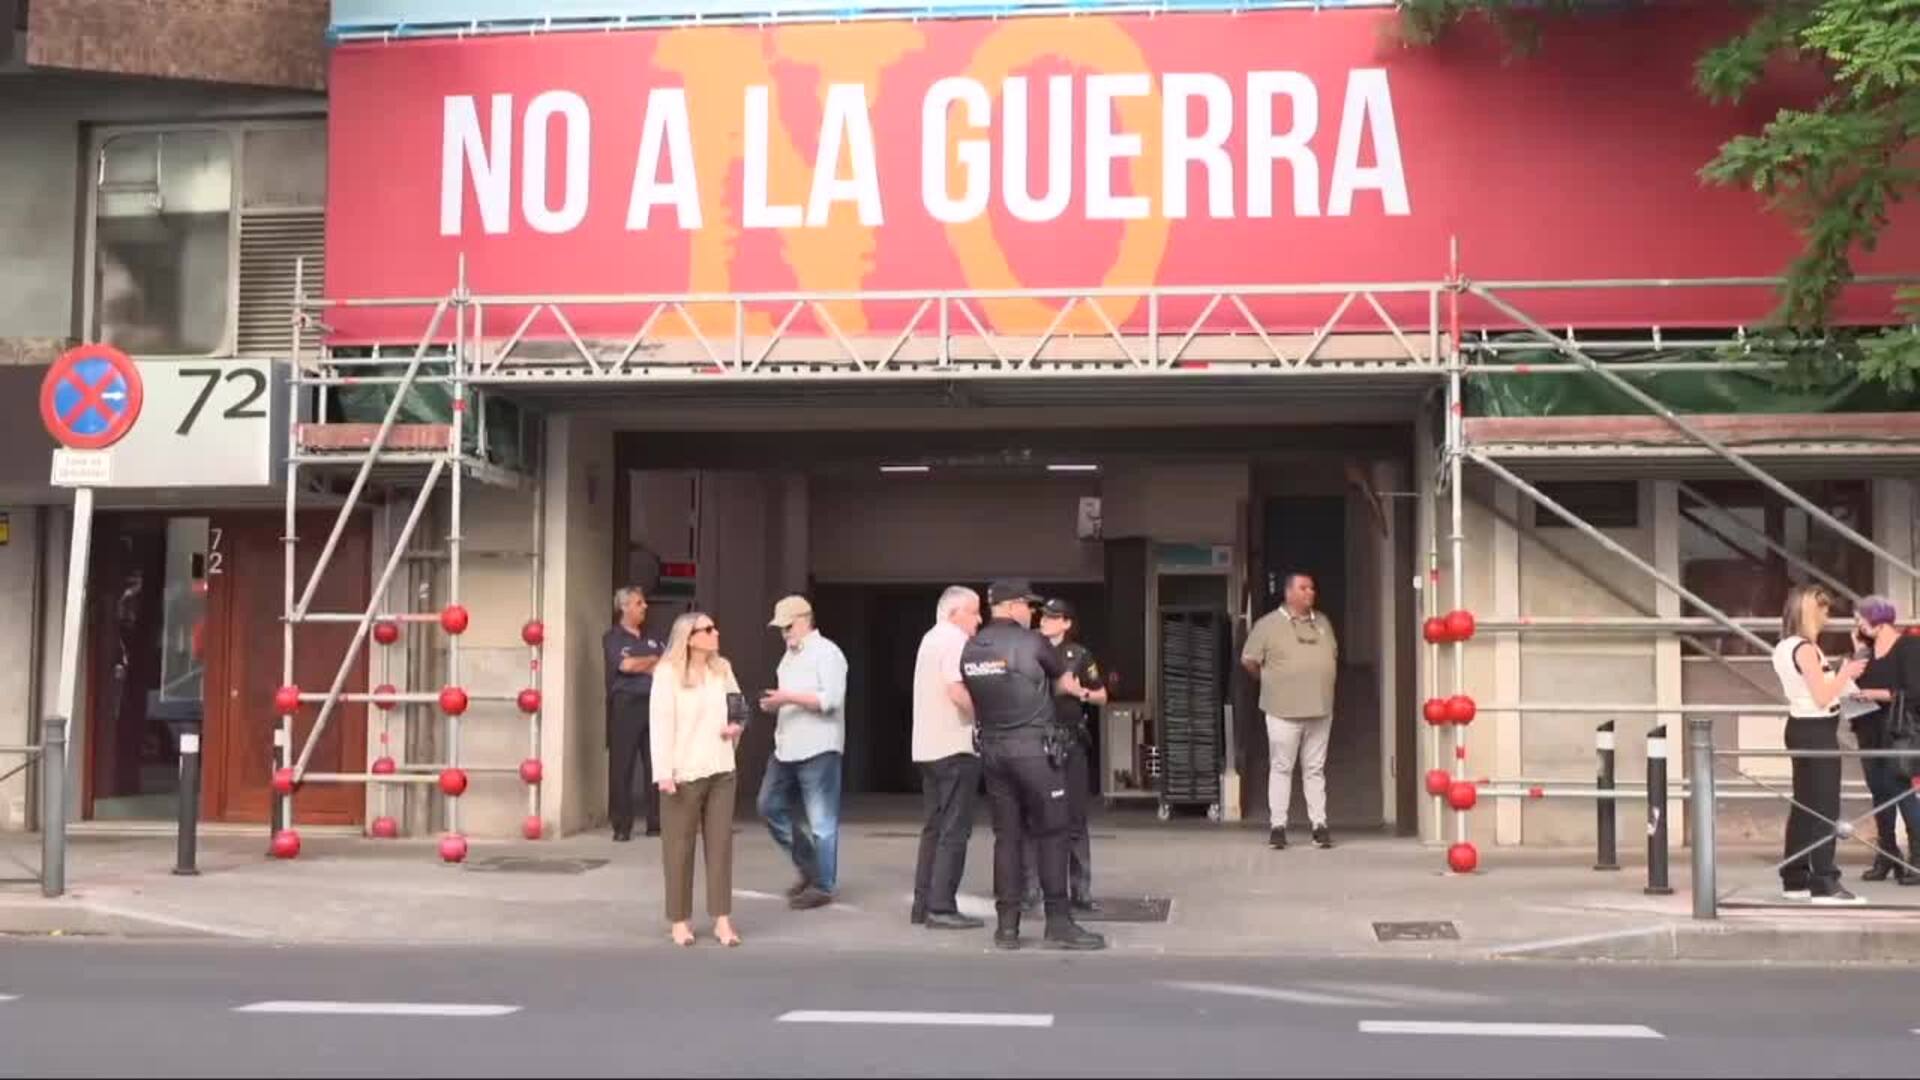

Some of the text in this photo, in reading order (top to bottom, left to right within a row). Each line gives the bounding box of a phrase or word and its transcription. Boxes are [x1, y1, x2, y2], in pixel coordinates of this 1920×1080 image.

[440, 68, 1412, 236] NO A LA GUERRA
[175, 368, 267, 435] 72
